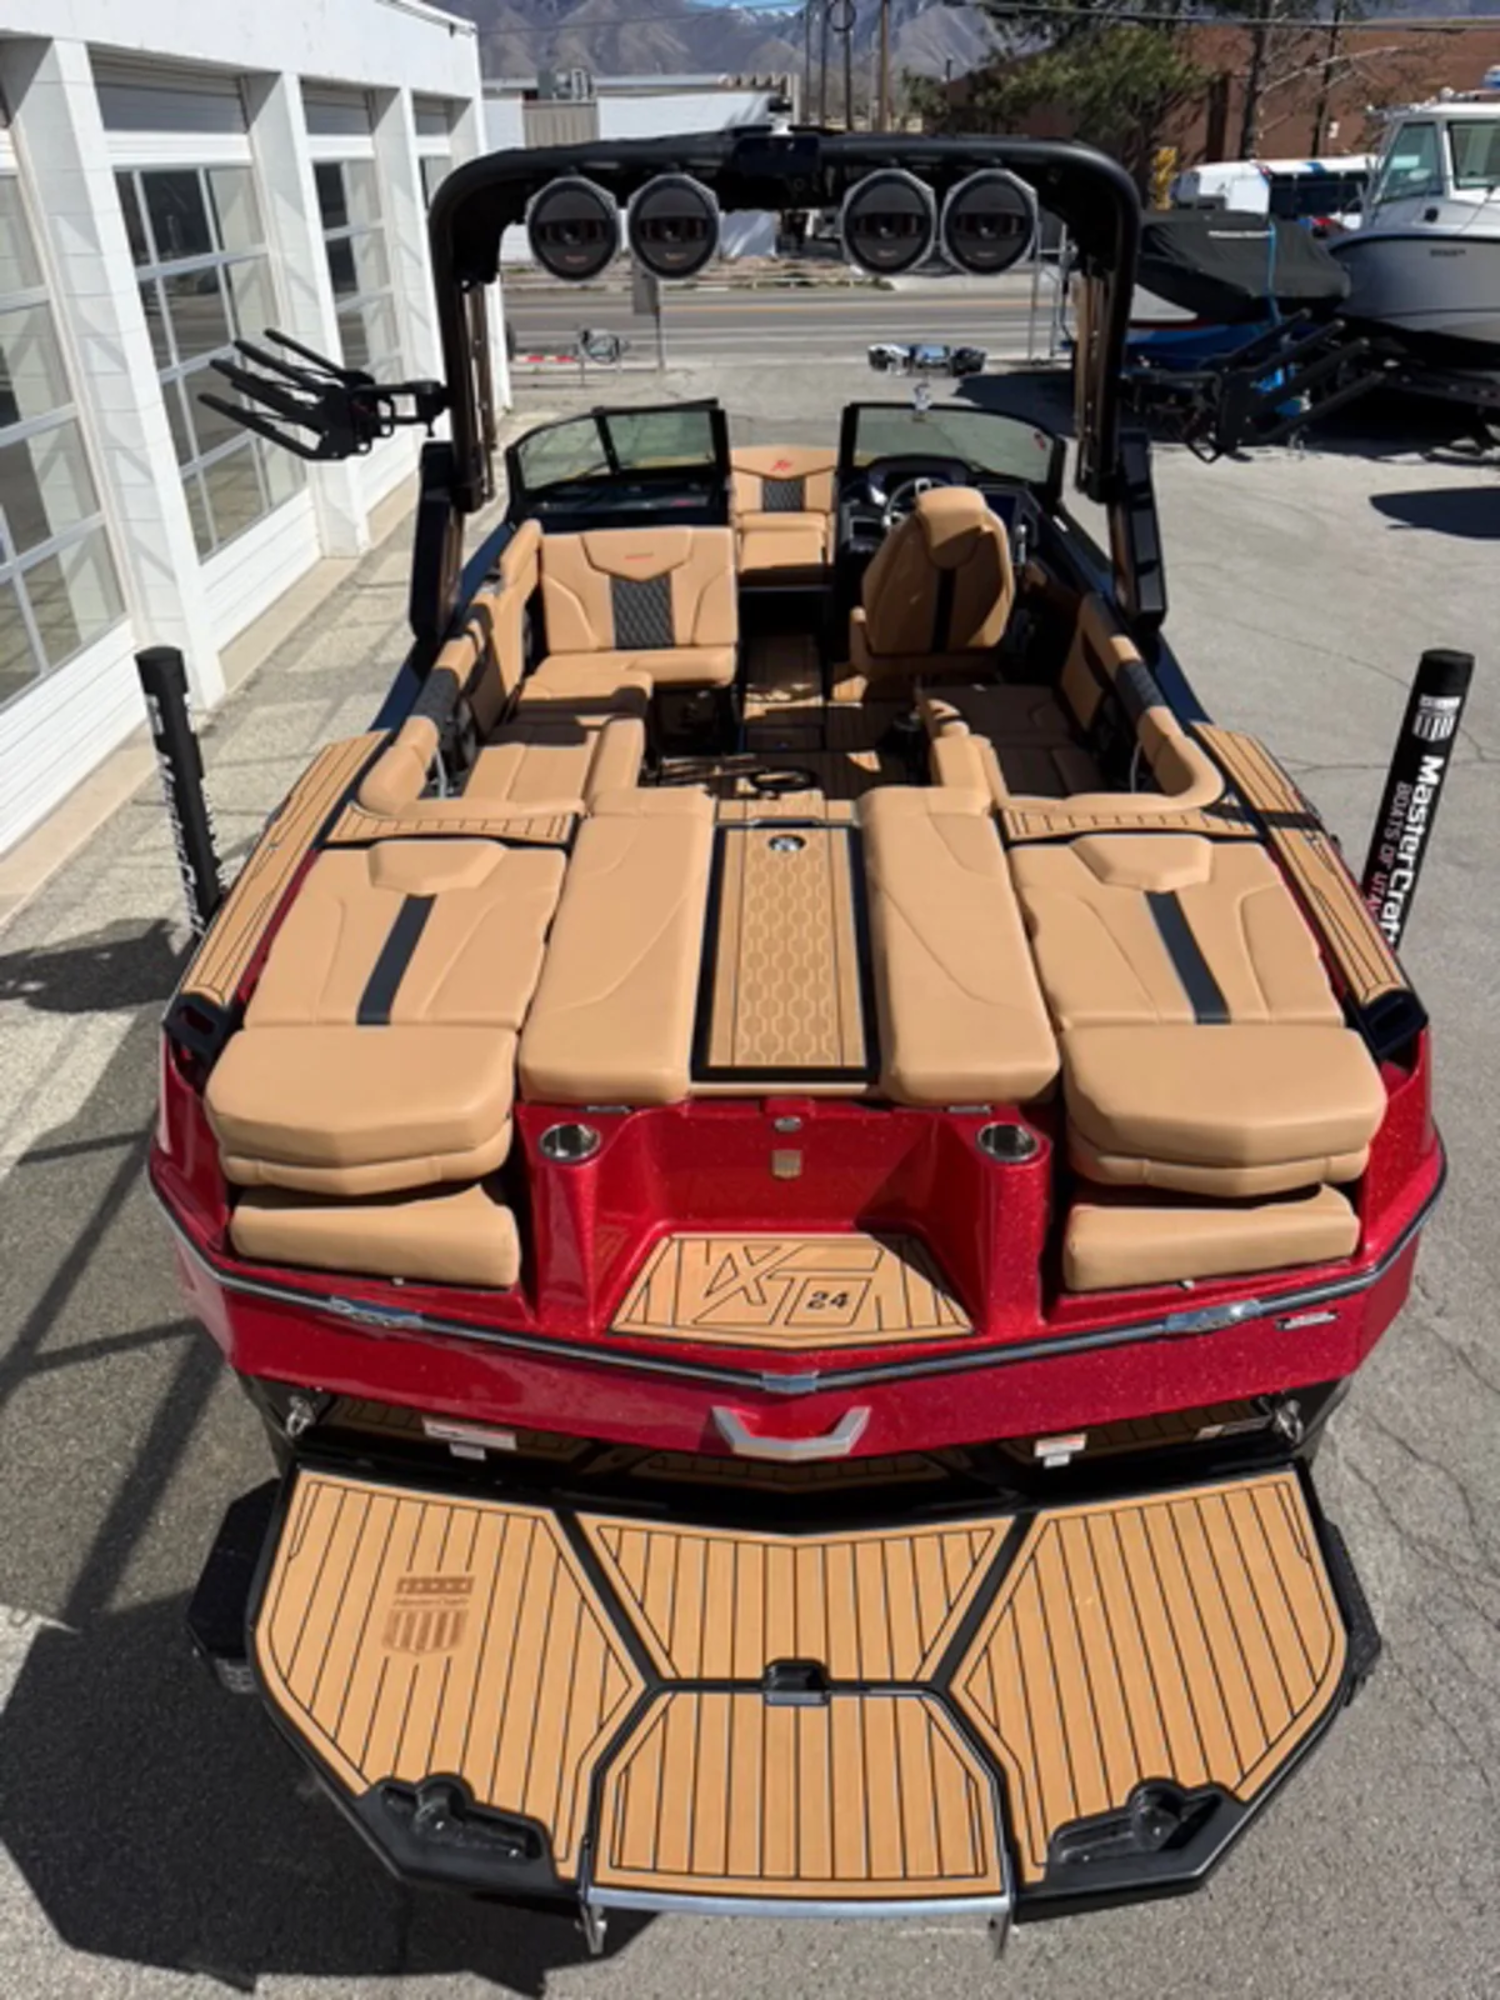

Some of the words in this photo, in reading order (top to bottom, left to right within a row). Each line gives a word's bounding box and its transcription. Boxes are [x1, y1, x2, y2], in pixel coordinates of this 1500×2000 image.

[1383, 781, 1413, 840] BOATS
[1378, 843, 1395, 870] OF
[806, 1290, 849, 1309] 24
